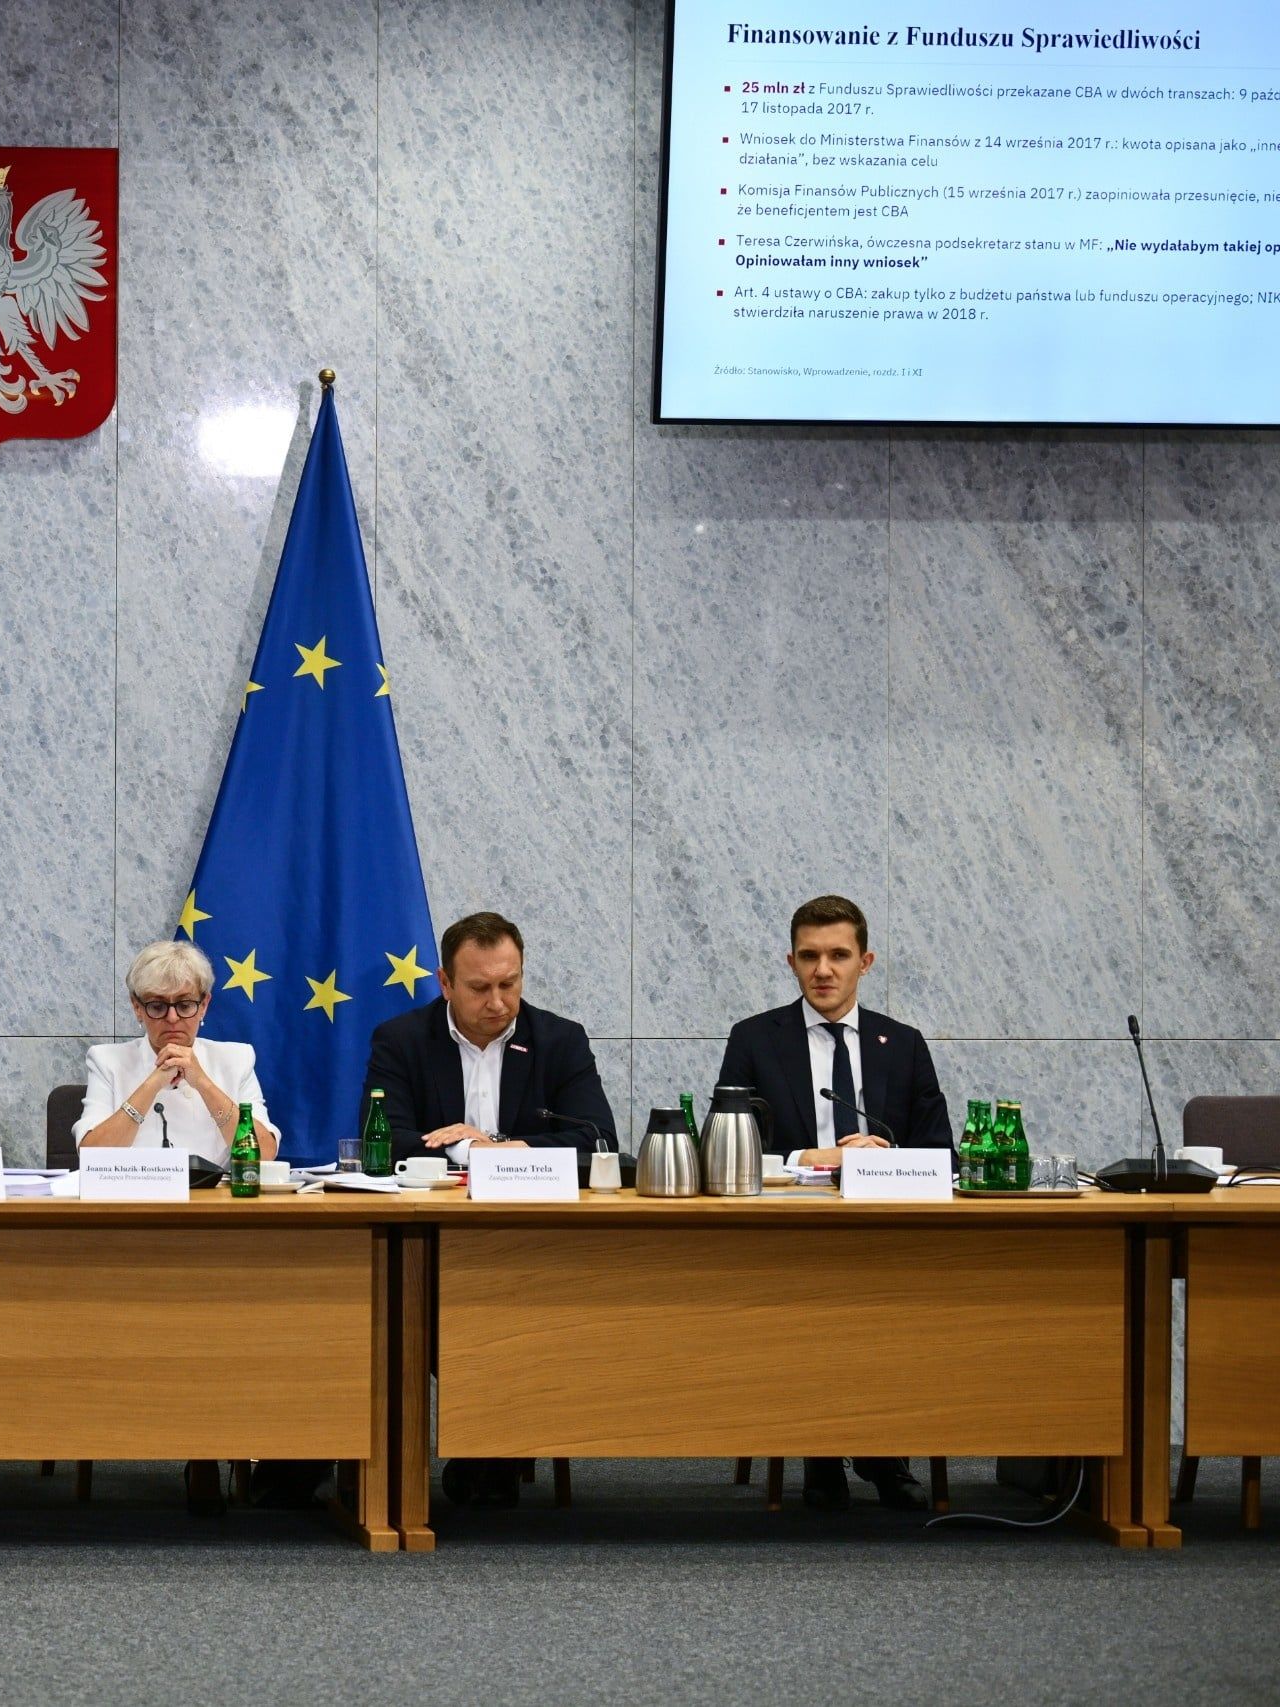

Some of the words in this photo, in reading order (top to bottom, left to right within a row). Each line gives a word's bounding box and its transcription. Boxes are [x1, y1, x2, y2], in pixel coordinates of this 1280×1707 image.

[727, 23, 880, 45] Finansowanie
[886, 31, 899, 45] z
[906, 26, 1014, 47] Funduszu
[1021, 27, 1200, 52] Sprawiedliwości
[742, 81, 760, 93] 25
[763, 81, 789, 94] mln
[792, 81, 806, 94] zł
[808, 85, 816, 94] z
[819, 82, 883, 95] Funduszu
[886, 83, 993, 98] Sprawiedliwości
[996, 85, 1072, 99] przekazane
[1075, 86, 1103, 98] CBA
[1106, 89, 1118, 98] w
[1120, 86, 1164, 99] dwóch
[1167, 87, 1235, 100] transzach:
[1239, 88, 1248, 100] 9
[741, 101, 759, 113] 17
[762, 101, 824, 116] listopada
[826, 102, 862, 115] 2017
[865, 106, 874, 115] r.
[739, 132, 796, 145] Wniosek
[799, 132, 817, 145] do
[820, 133, 905, 146] Ministerstwa
[908, 134, 971, 147] Finansów
[974, 138, 982, 148] z
[984, 135, 1002, 148] 14
[1005, 136, 1064, 149] września
[1067, 136, 1102, 149] 2017
[1105, 139, 1120, 149] r.:
[1122, 137, 1162, 150] kwota
[1164, 138, 1216, 153] opisana
[1218, 138, 1247, 154] jako
[739, 152, 808, 166] działania”,
[812, 153, 836, 166] bez
[839, 153, 908, 166] wskazania
[910, 154, 938, 167] celu
[738, 183, 791, 198] Komisja
[794, 184, 857, 197] Finansów
[860, 184, 939, 200] Publicznych
[943, 185, 965, 199] (15
[968, 186, 1026, 199] września
[1030, 187, 1065, 199] 2017
[1068, 187, 1082, 202] r.)
[1084, 188, 1171, 202] zaopiniowała
[1174, 189, 1260, 204] przesunięcie,
[1263, 189, 1280, 202] nie
[736, 203, 752, 215] że
[755, 203, 850, 219] beneficjentem
[852, 204, 878, 220] jest
[881, 205, 909, 217] CBA
[736, 234, 781, 247] Teresa
[784, 235, 863, 249] Czerwińska,
[866, 235, 932, 248] ówczesna
[935, 237, 1022, 251] podsekretarz
[1024, 239, 1061, 250] stanu
[1064, 241, 1076, 250] w
[1079, 238, 1103, 250] MF:
[1106, 238, 1137, 252] „Nie
[1140, 239, 1220, 254] wydałabym
[1222, 239, 1262, 255] takiej
[1264, 243, 1280, 255] op
[735, 254, 827, 269] Opiniowałam
[830, 255, 860, 270] inny
[863, 255, 928, 268] wniosek”
[733, 285, 758, 298] Art.
[761, 286, 770, 298] 4
[774, 287, 821, 301] ustawy
[824, 289, 833, 299] o
[836, 287, 868, 299] CBA:
[870, 287, 910, 302] zakup
[914, 287, 946, 303] tylko
[948, 291, 956, 300] z
[959, 288, 1012, 301] budżetu
[1016, 288, 1072, 303] państwa
[1075, 289, 1096, 302] lub
[1099, 289, 1159, 302] funduszu
[1162, 291, 1254, 306] operacyjnego;
[1257, 291, 1280, 303] NIK
[733, 305, 805, 318] stwierdziła
[808, 306, 880, 319] naruszenie
[883, 310, 924, 321] prawa
[927, 310, 939, 320] w
[942, 307, 977, 320] 2018
[980, 311, 989, 320] r.
[114, 1165, 184, 1173] Kluzik-Rostkowska
[496, 1165, 527, 1173] Tomasz
[531, 1165, 553, 1173] Trela
[856, 1168, 893, 1176] Mateusz
[896, 1168, 938, 1177] Bochenek
